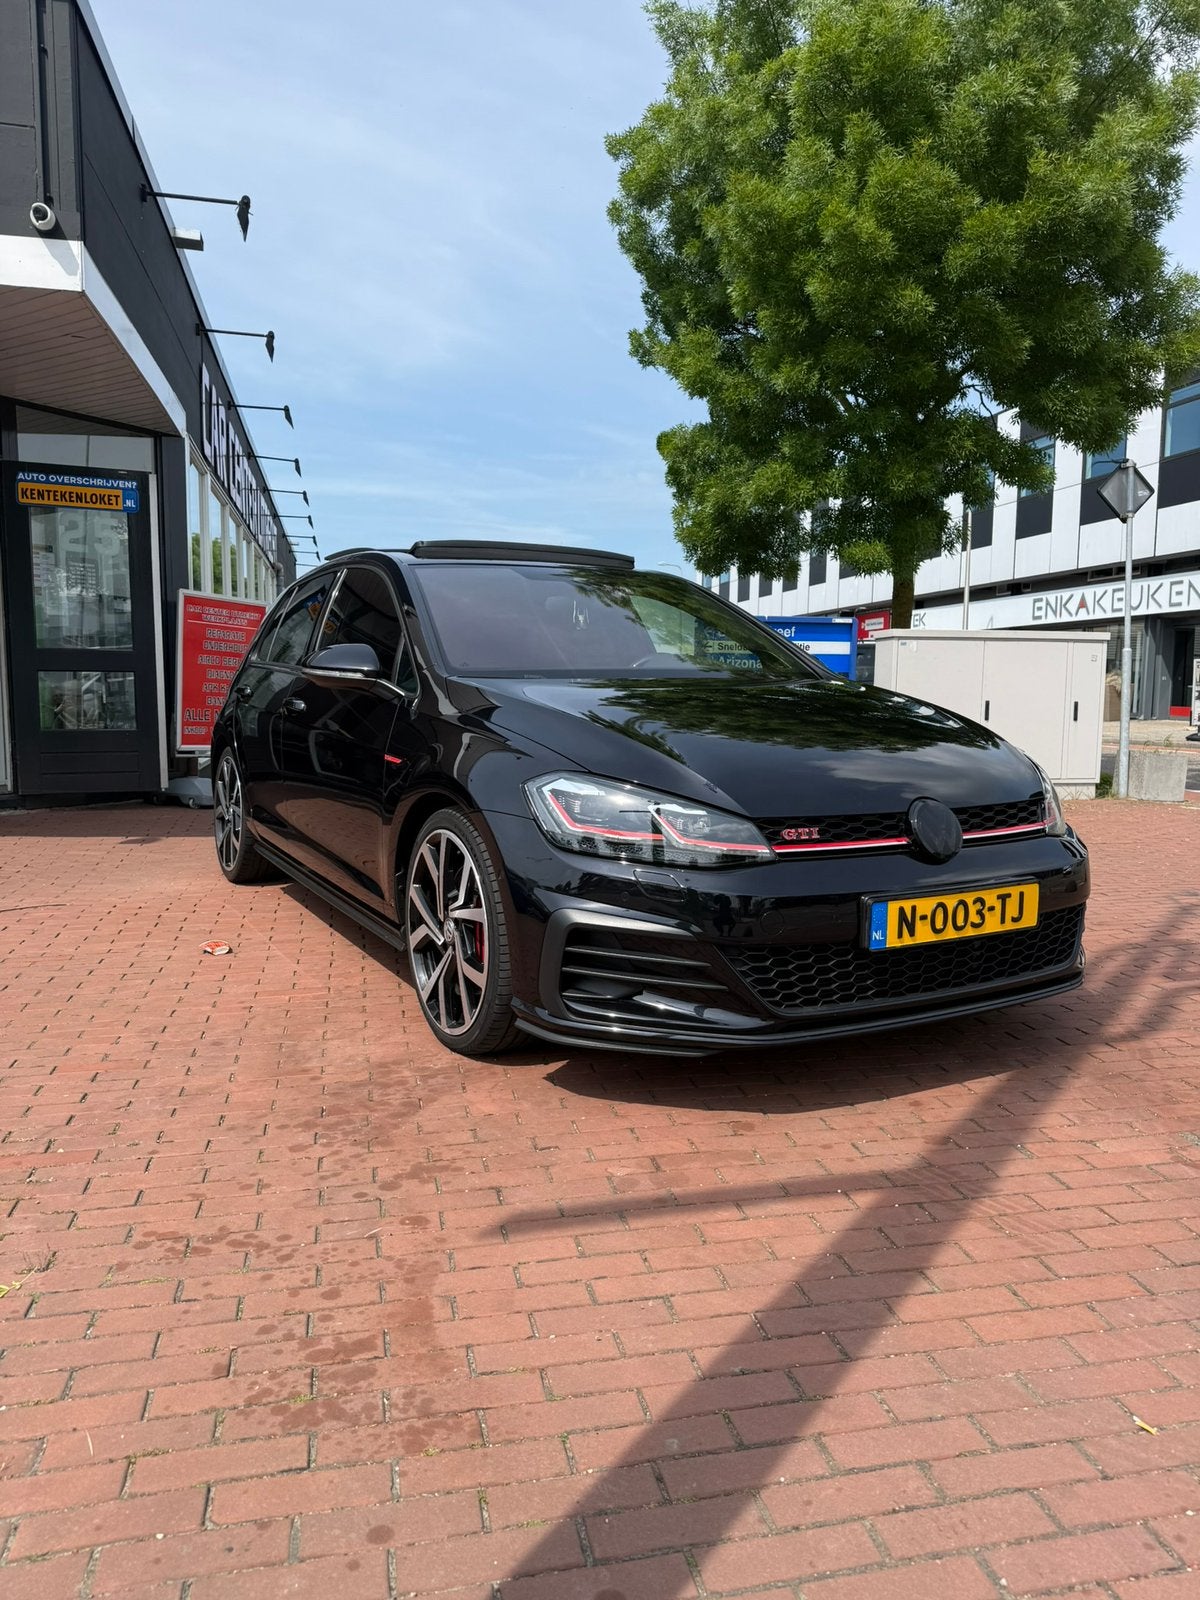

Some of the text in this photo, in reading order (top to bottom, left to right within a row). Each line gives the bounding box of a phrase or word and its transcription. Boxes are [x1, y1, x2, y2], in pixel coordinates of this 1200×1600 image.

[202, 362, 227, 490] CAR
[17, 472, 138, 489] AUTO OVERSCHRIJVEN?
[20, 487, 120, 506] KENTEKENLOKET
[912, 612, 927, 628] EK
[206, 628, 246, 642] REPARATIE
[197, 654, 221, 666] AIRCO
[184, 707, 211, 722] ALLE
[781, 827, 820, 841] GTI
[872, 890, 1025, 941] NL N-003-TJ
